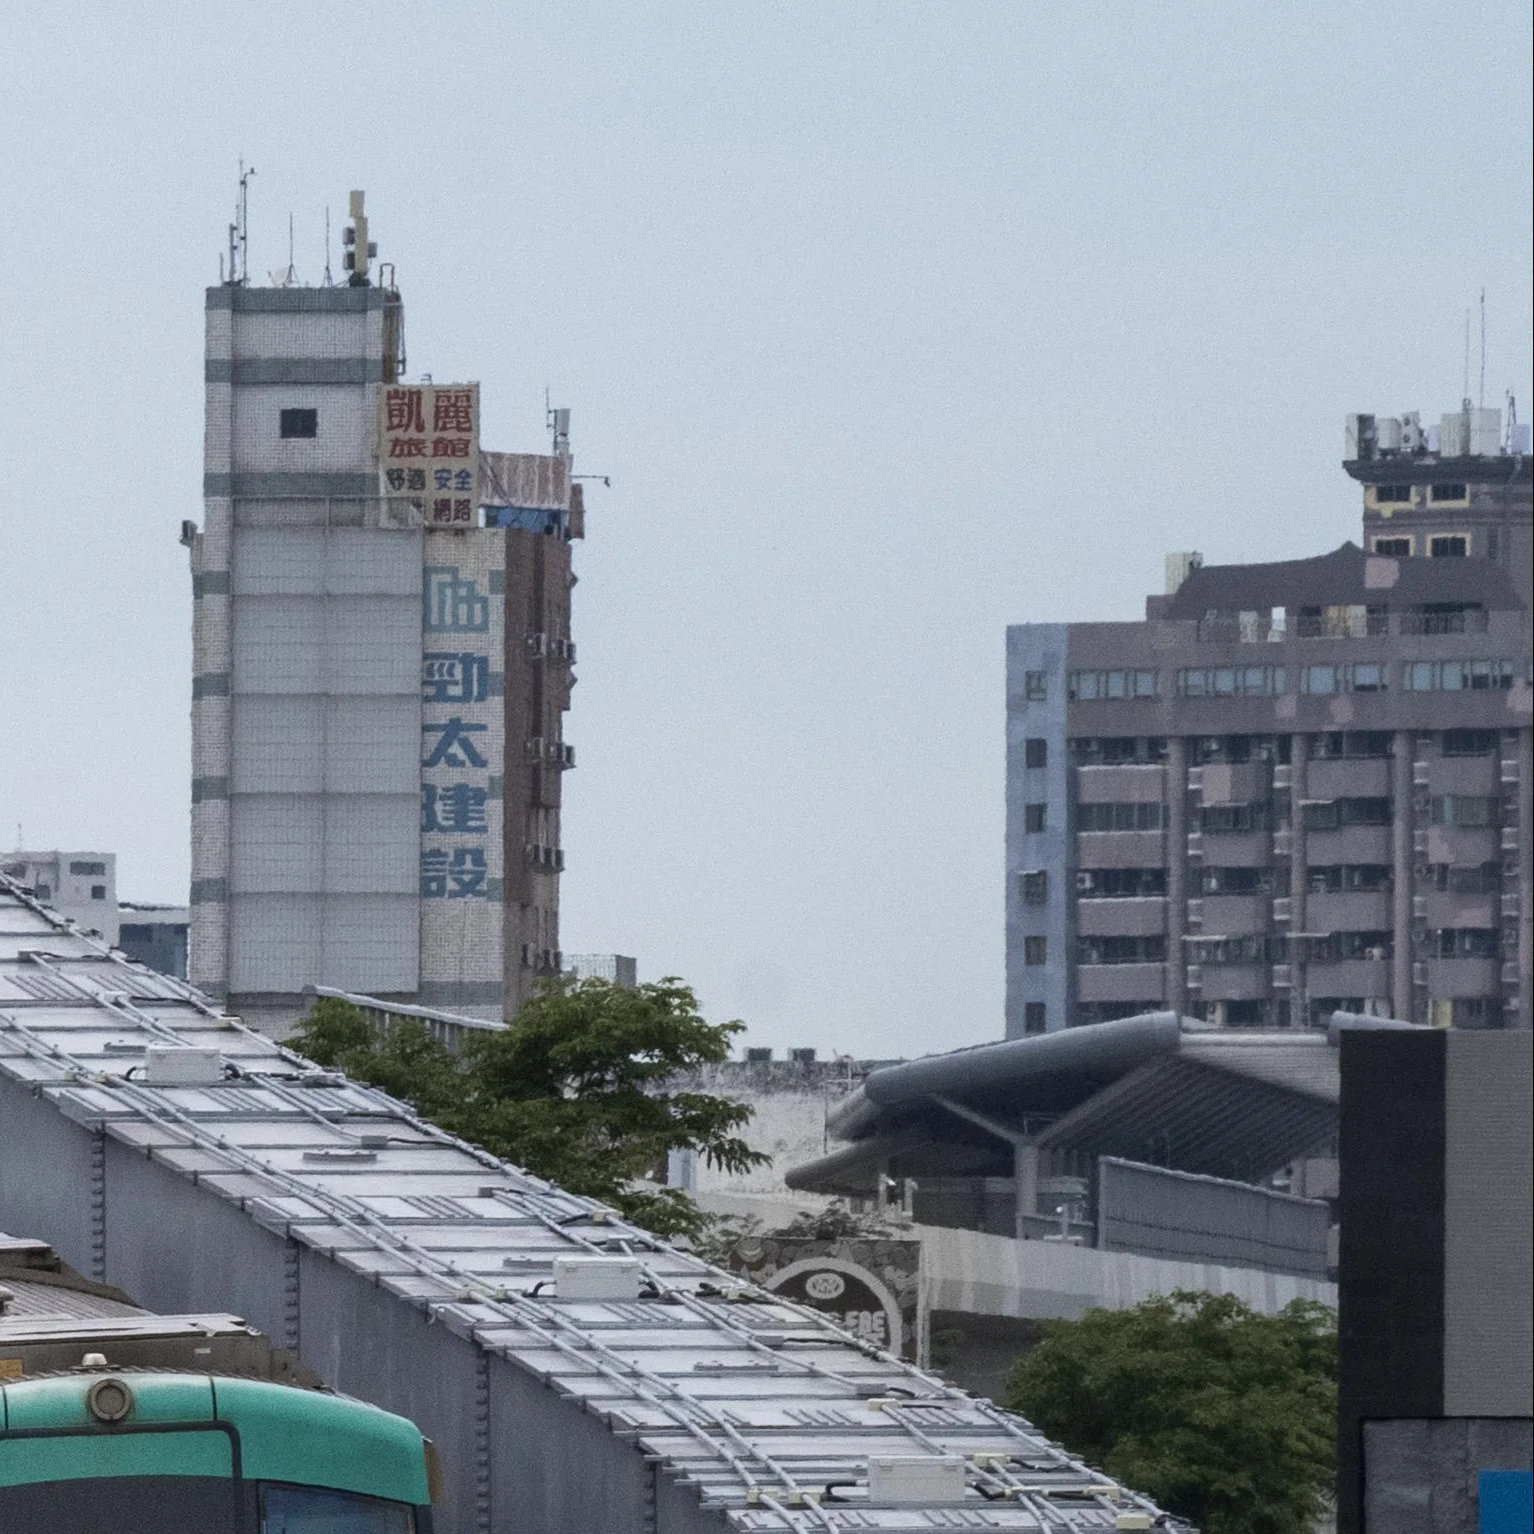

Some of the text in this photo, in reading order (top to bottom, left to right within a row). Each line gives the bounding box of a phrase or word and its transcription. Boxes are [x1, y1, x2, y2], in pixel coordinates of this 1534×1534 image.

[385, 388, 473, 433] 凱麗
[388, 437, 472, 458] 旅館
[421, 652, 489, 898] 勁太建設
